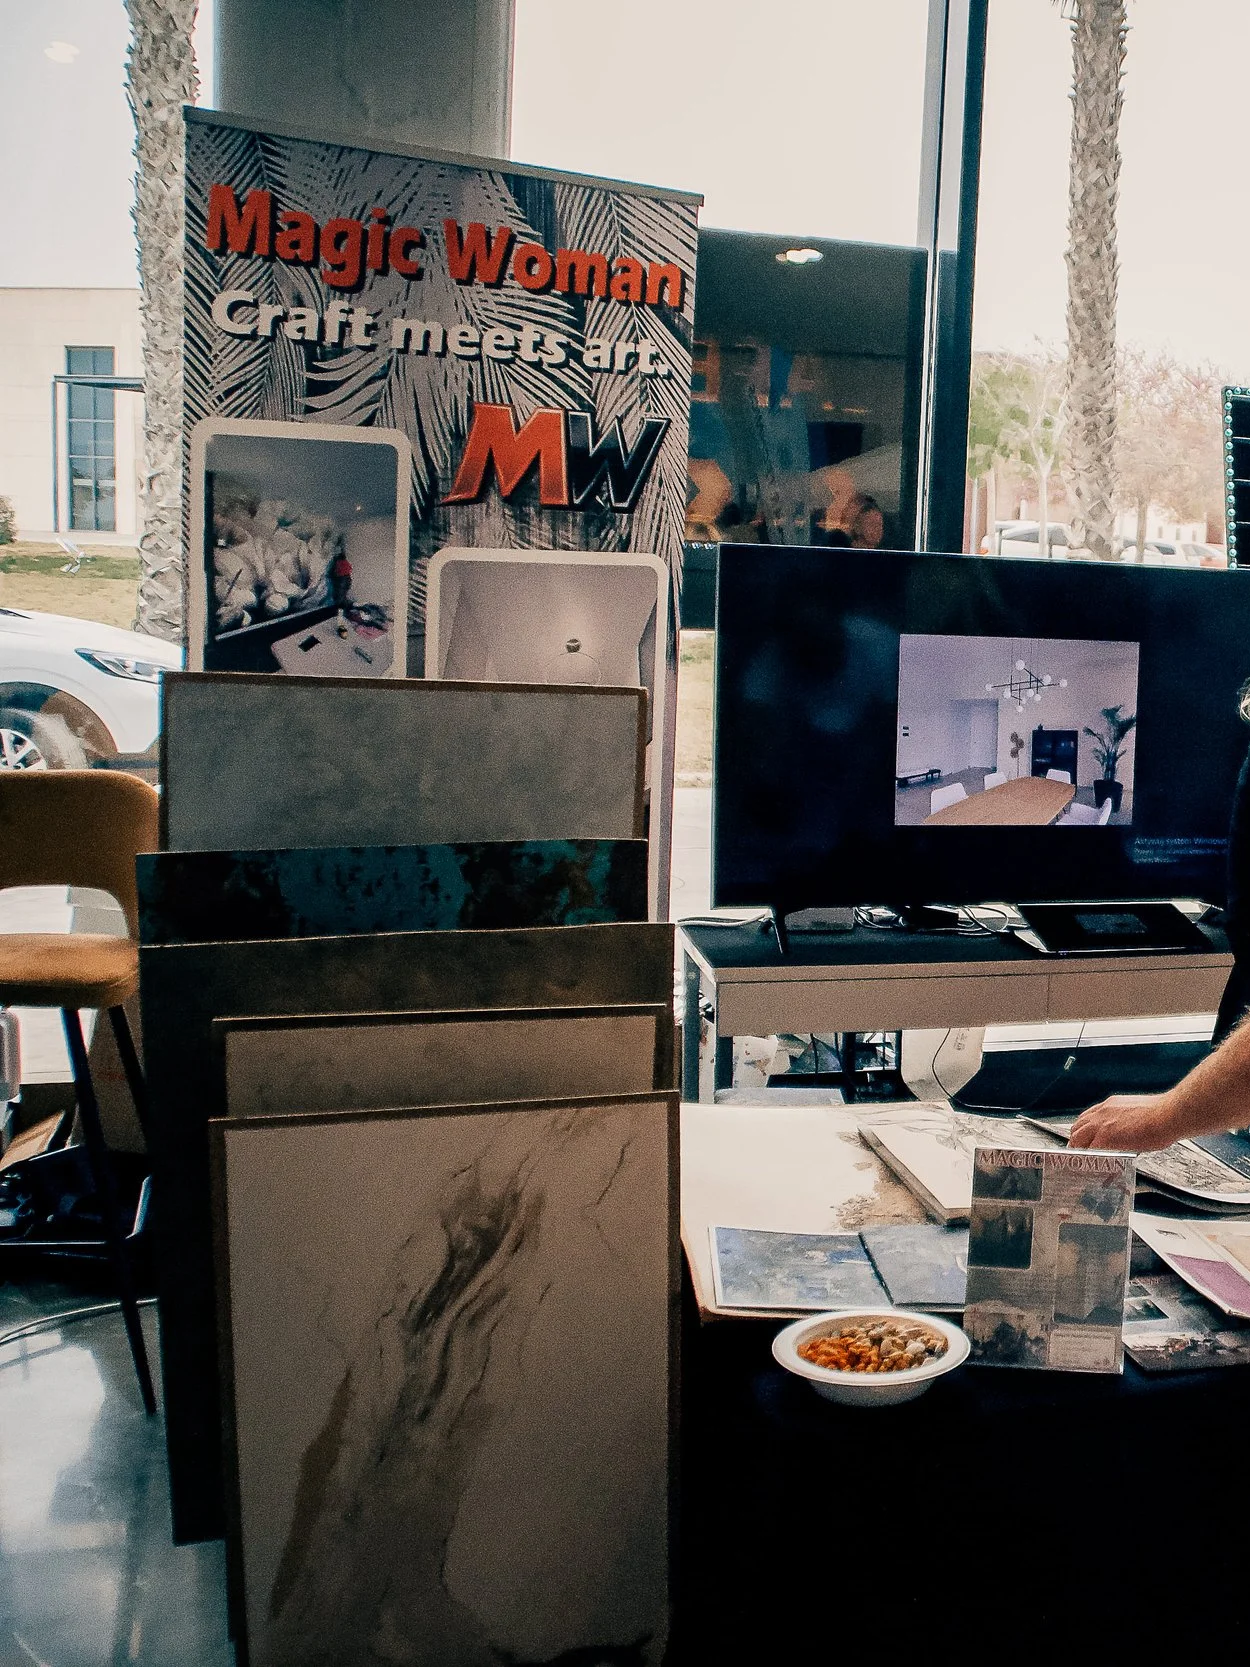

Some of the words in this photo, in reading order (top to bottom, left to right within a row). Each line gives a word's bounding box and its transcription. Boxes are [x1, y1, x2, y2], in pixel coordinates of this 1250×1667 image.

[206, 183, 427, 289] Magic
[444, 217, 684, 309] Woman
[211, 289, 377, 350] Craft
[393, 320, 568, 366] meets
[582, 336, 671, 378] art.
[441, 402, 671, 513] MW
[979, 1150, 1045, 1169] MAGIC
[1049, 1154, 1126, 1173] WOMAN
